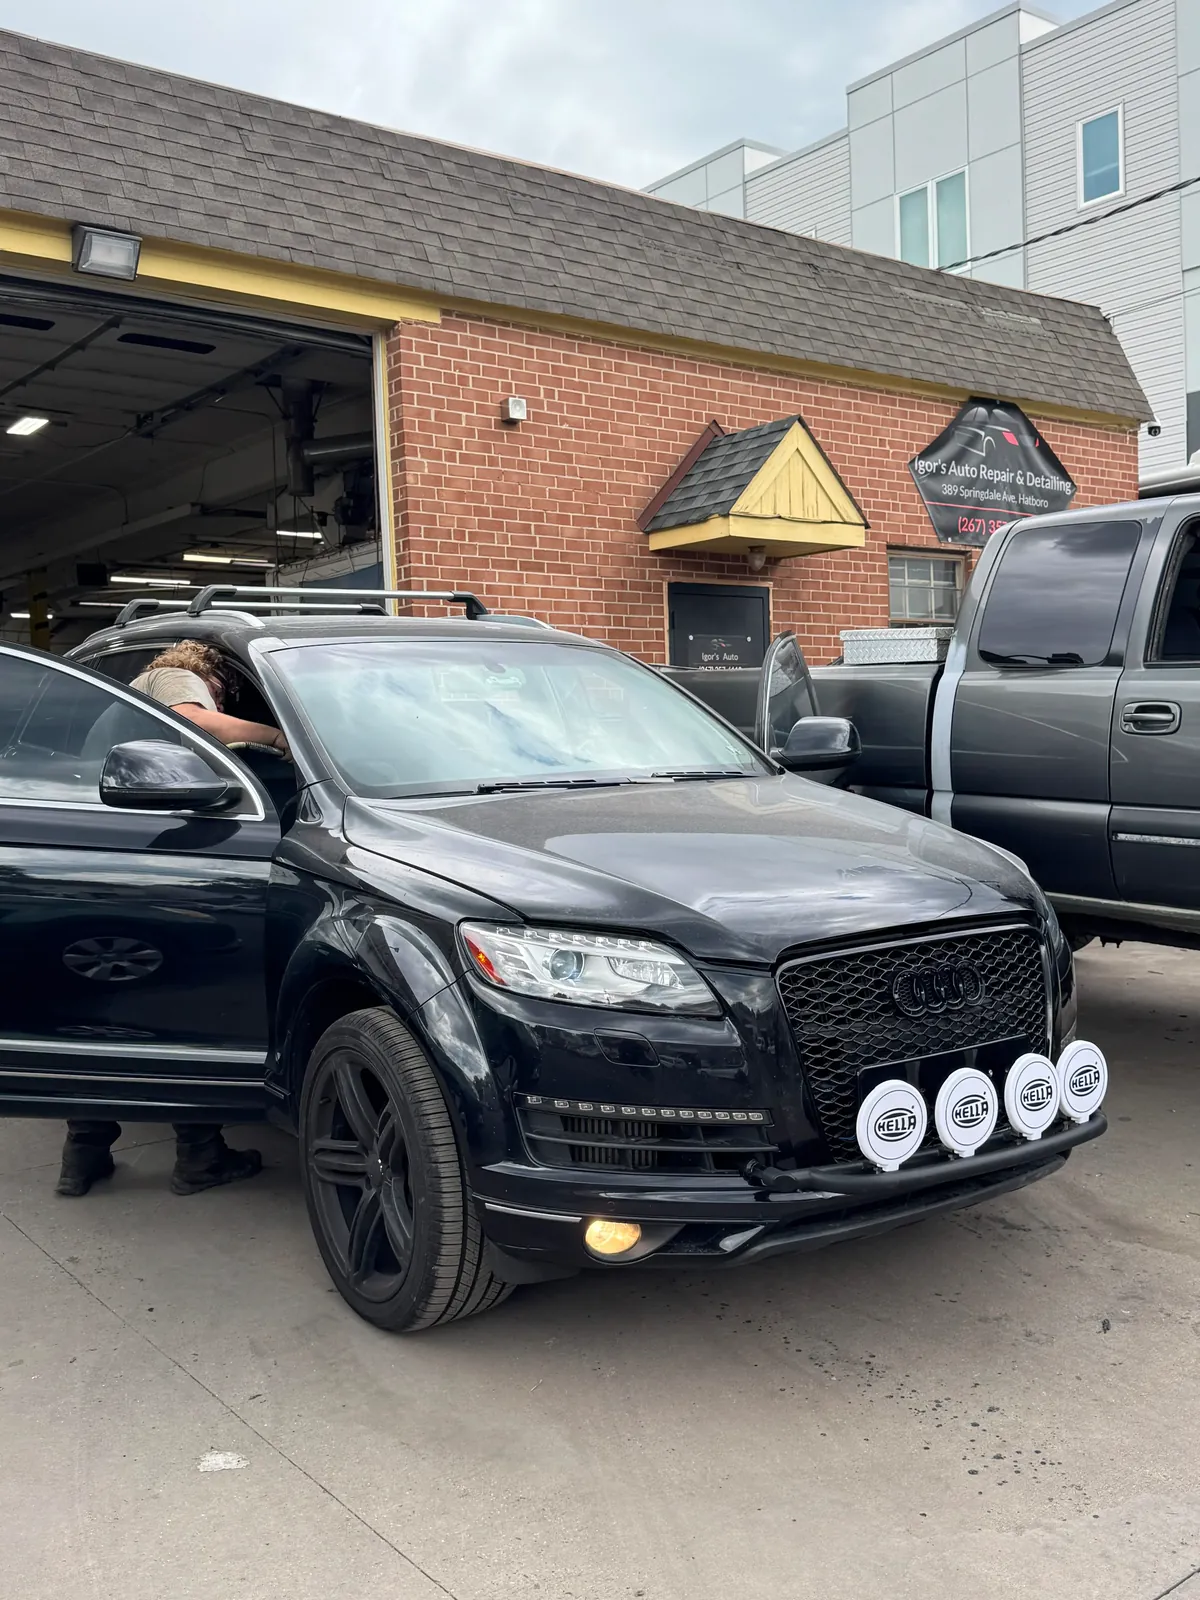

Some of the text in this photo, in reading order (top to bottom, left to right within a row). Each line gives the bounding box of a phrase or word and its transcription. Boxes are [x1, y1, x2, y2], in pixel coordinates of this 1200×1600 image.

[914, 455, 1072, 495] Igor's Auto Repair & Detailing
[941, 484, 959, 496] 389
[959, 486, 1002, 501] Springdale
[1018, 493, 1049, 508] Hatboro
[958, 516, 986, 535] (267)
[701, 652, 739, 662] Igor's Auto
[1070, 1069, 1100, 1089] HELLA
[1022, 1088, 1053, 1104] HELLA
[954, 1100, 989, 1119] HELLA
[877, 1113, 917, 1132] HELLA
